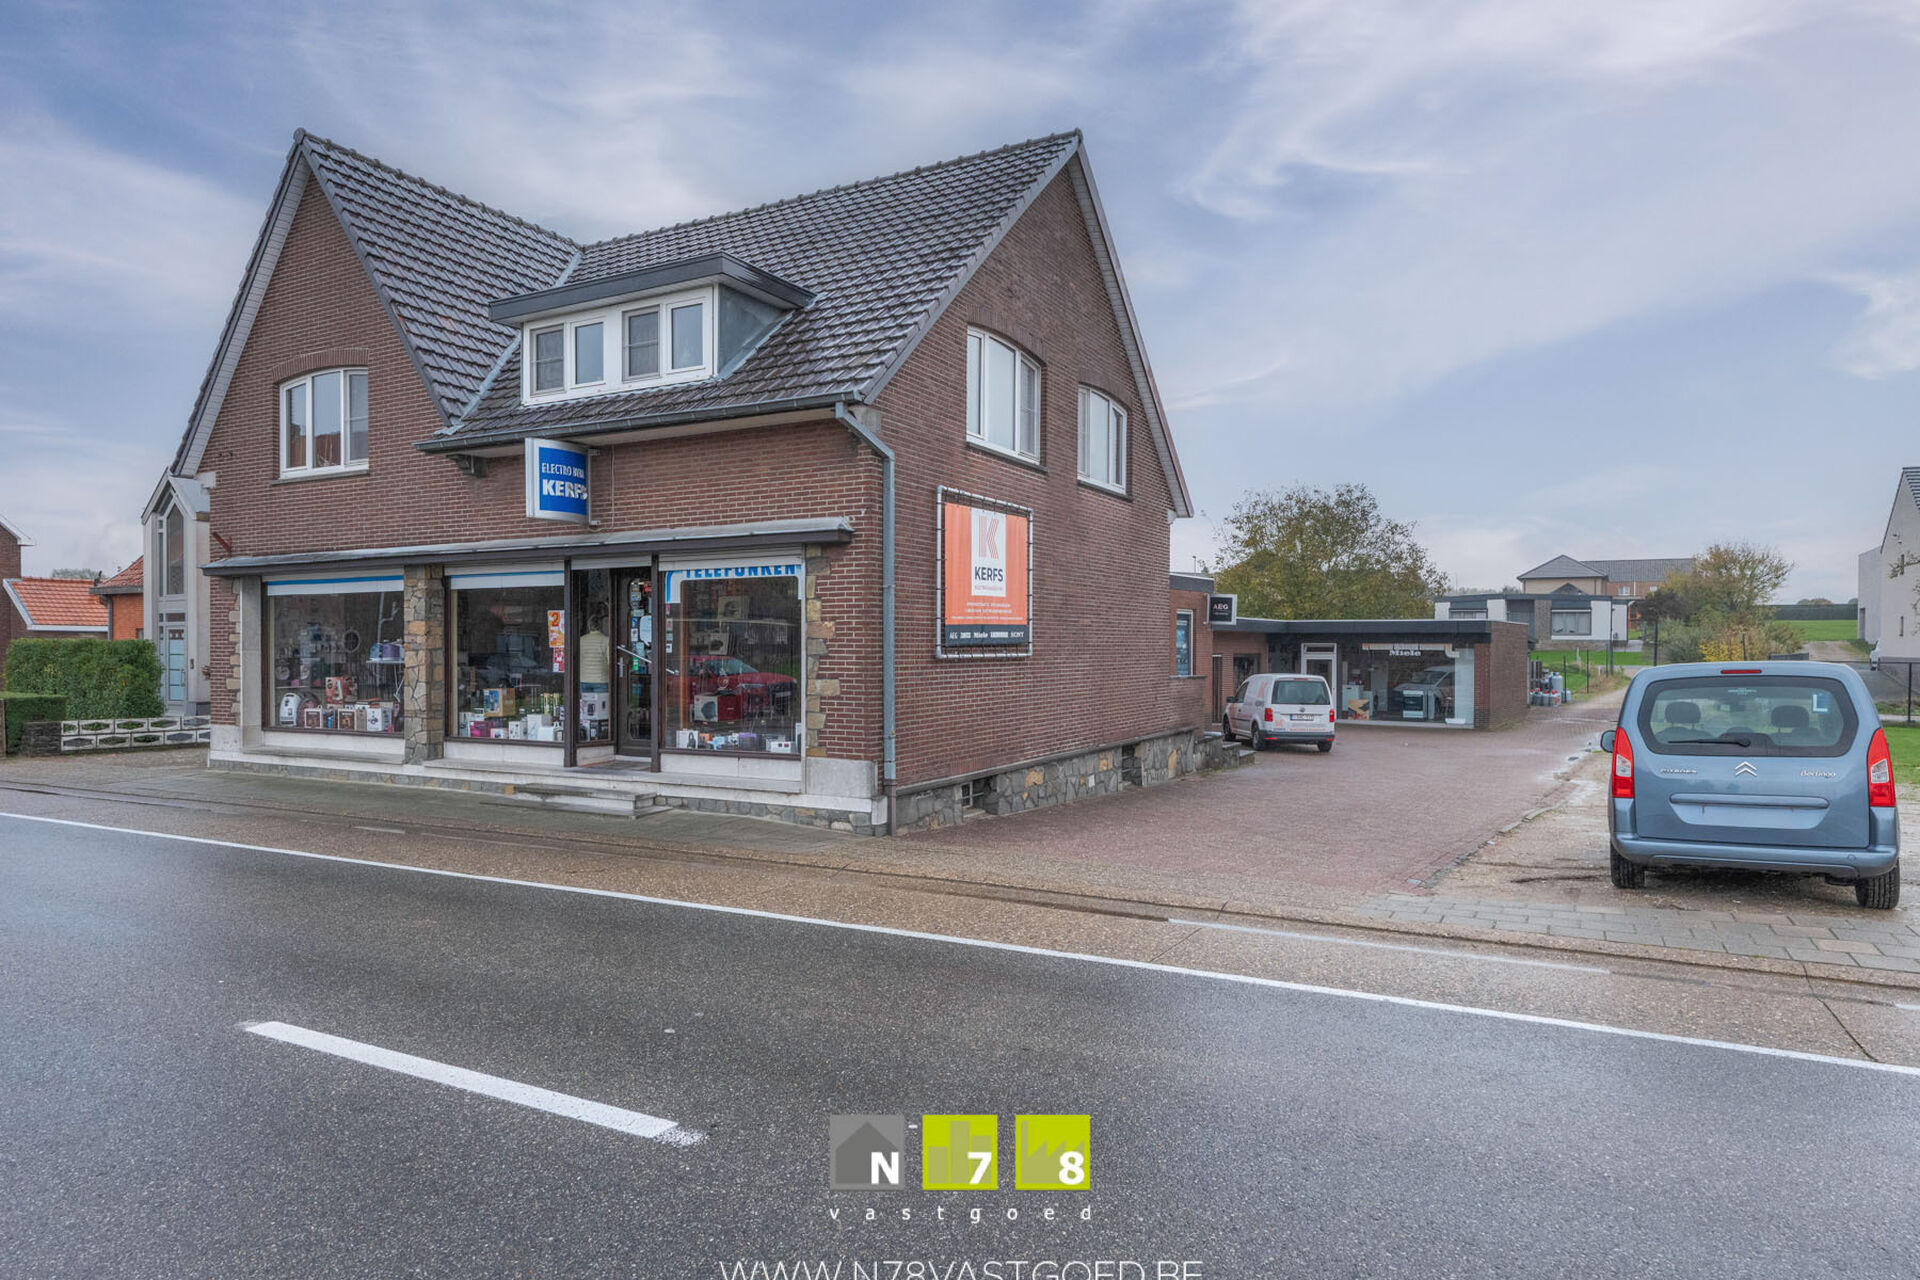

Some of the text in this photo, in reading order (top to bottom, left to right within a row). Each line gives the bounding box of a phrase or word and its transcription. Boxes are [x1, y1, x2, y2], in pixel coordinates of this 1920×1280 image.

[541, 462, 572, 476] ELECTRO
[542, 478, 588, 500] KERFS
[974, 566, 1004, 582] KERFS
[1812, 694, 1829, 712] L
